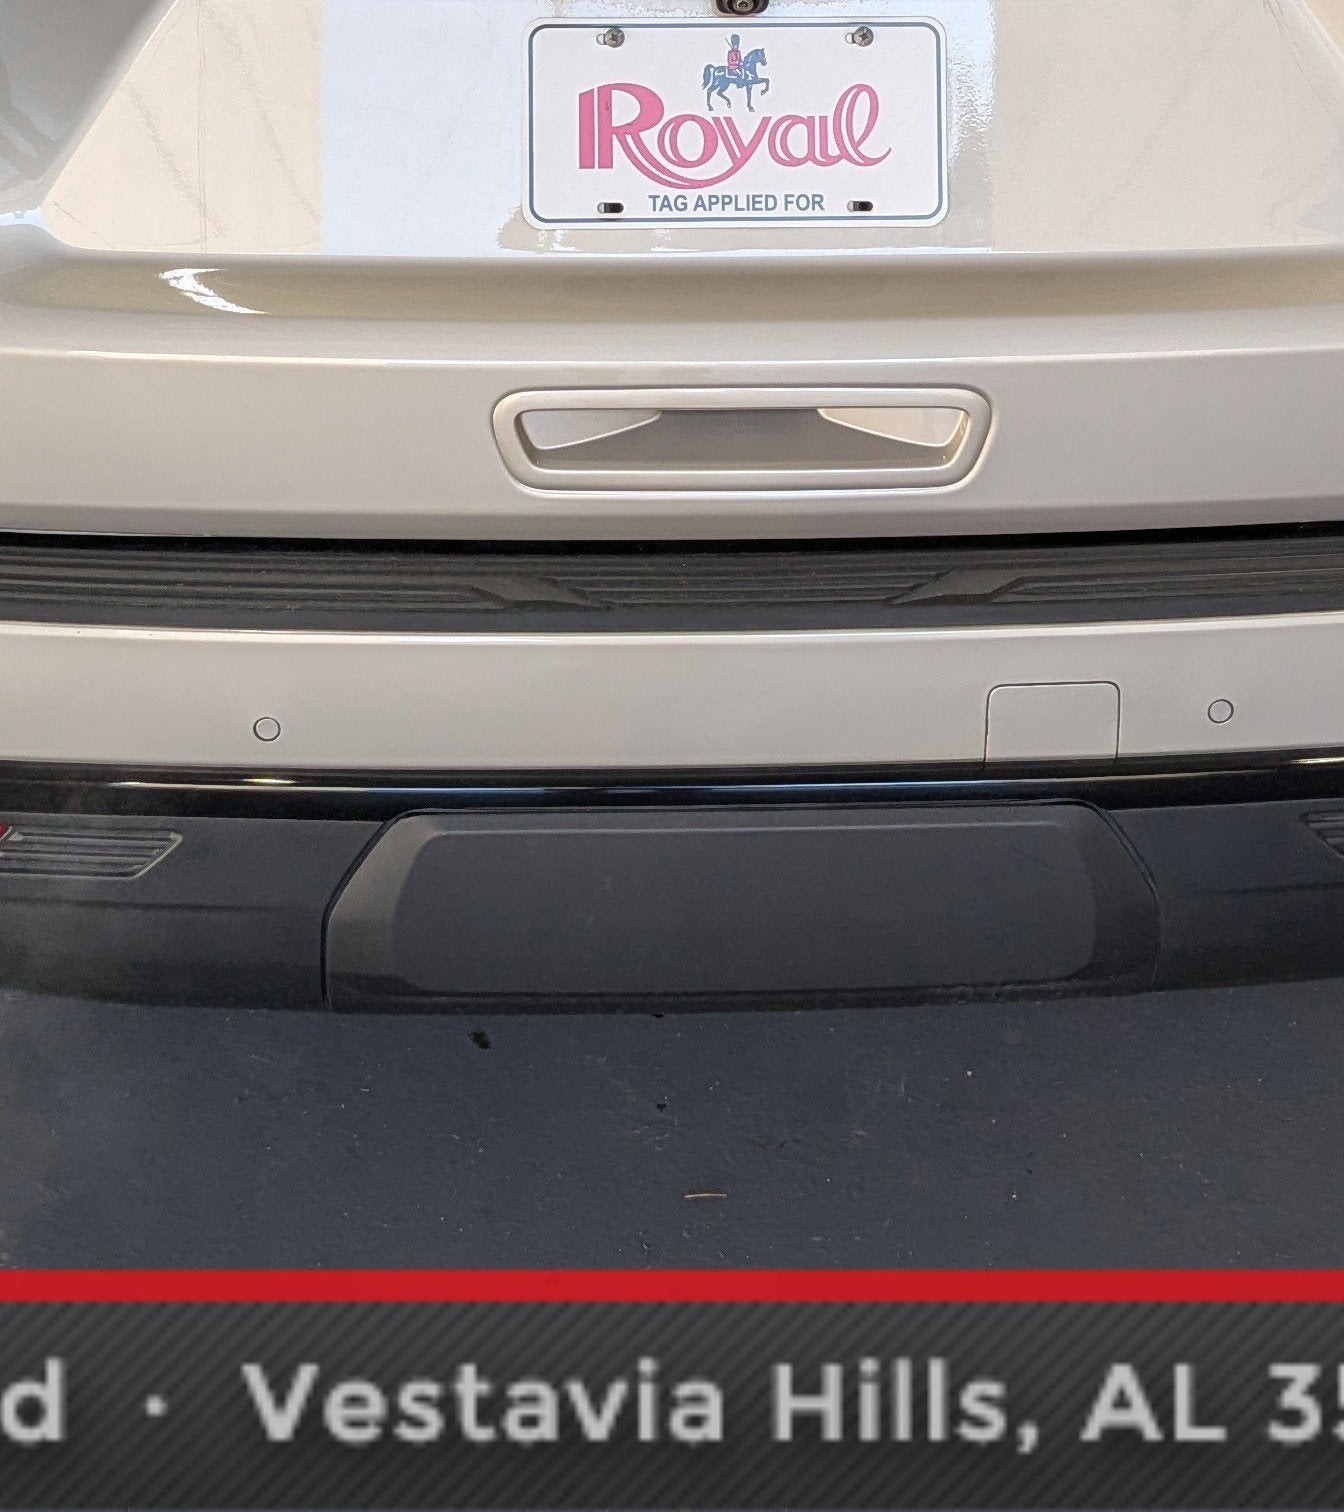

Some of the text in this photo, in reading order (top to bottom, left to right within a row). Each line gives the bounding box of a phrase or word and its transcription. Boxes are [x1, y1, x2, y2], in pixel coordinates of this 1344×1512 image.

[577, 82, 892, 190] Royal
[648, 193, 826, 212] TAG APPLIED FOR
